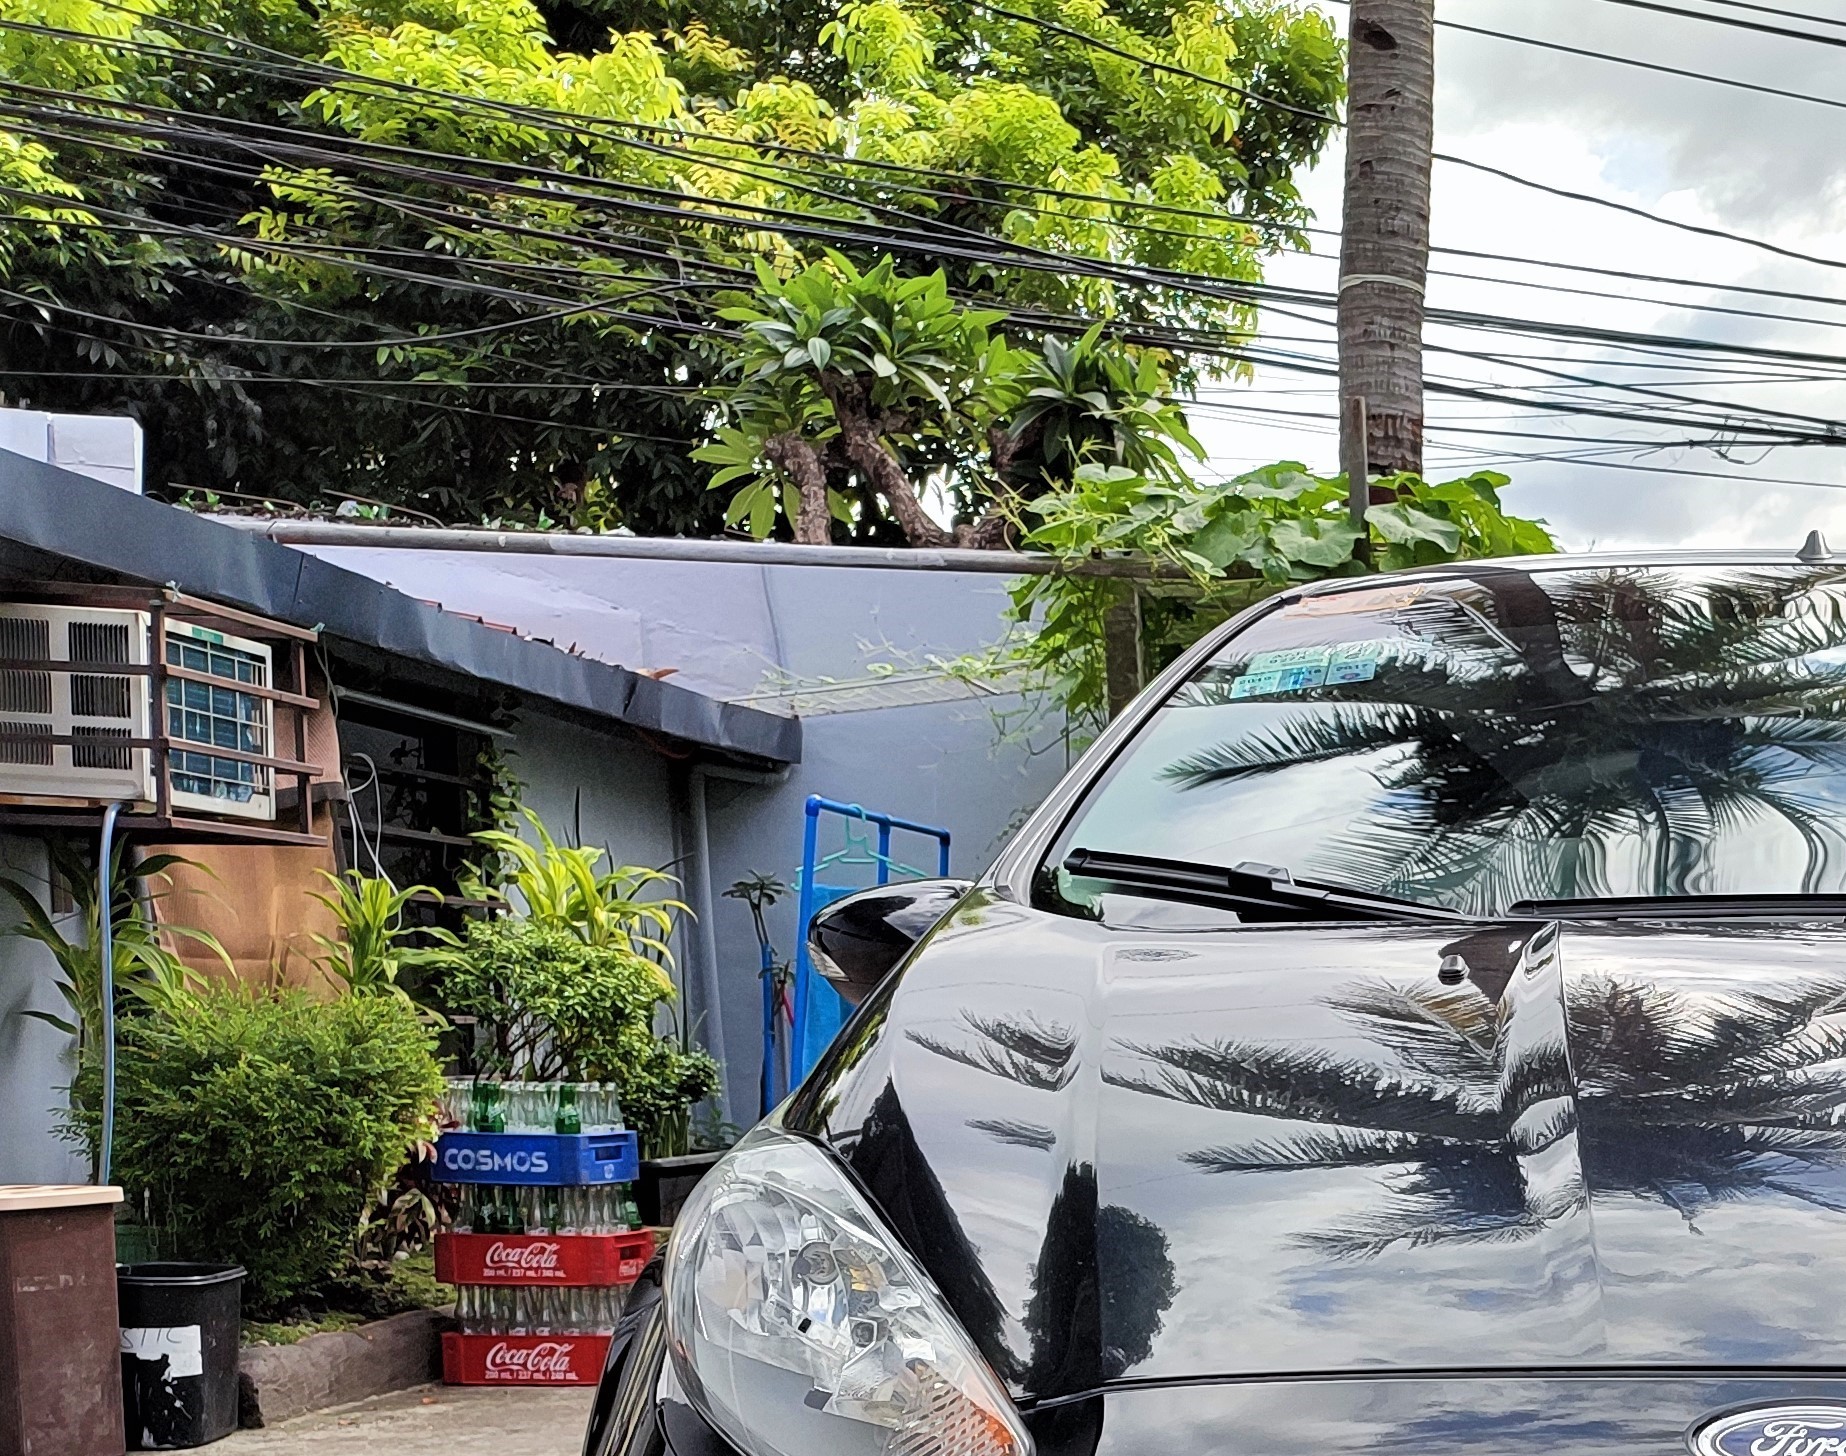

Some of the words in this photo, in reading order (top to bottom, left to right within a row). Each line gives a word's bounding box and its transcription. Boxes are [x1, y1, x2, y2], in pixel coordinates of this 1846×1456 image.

[444, 1148, 549, 1173] COSMOS
[485, 1241, 560, 1268] Coca-Cola
[485, 1342, 576, 1371] Coca-Cola
